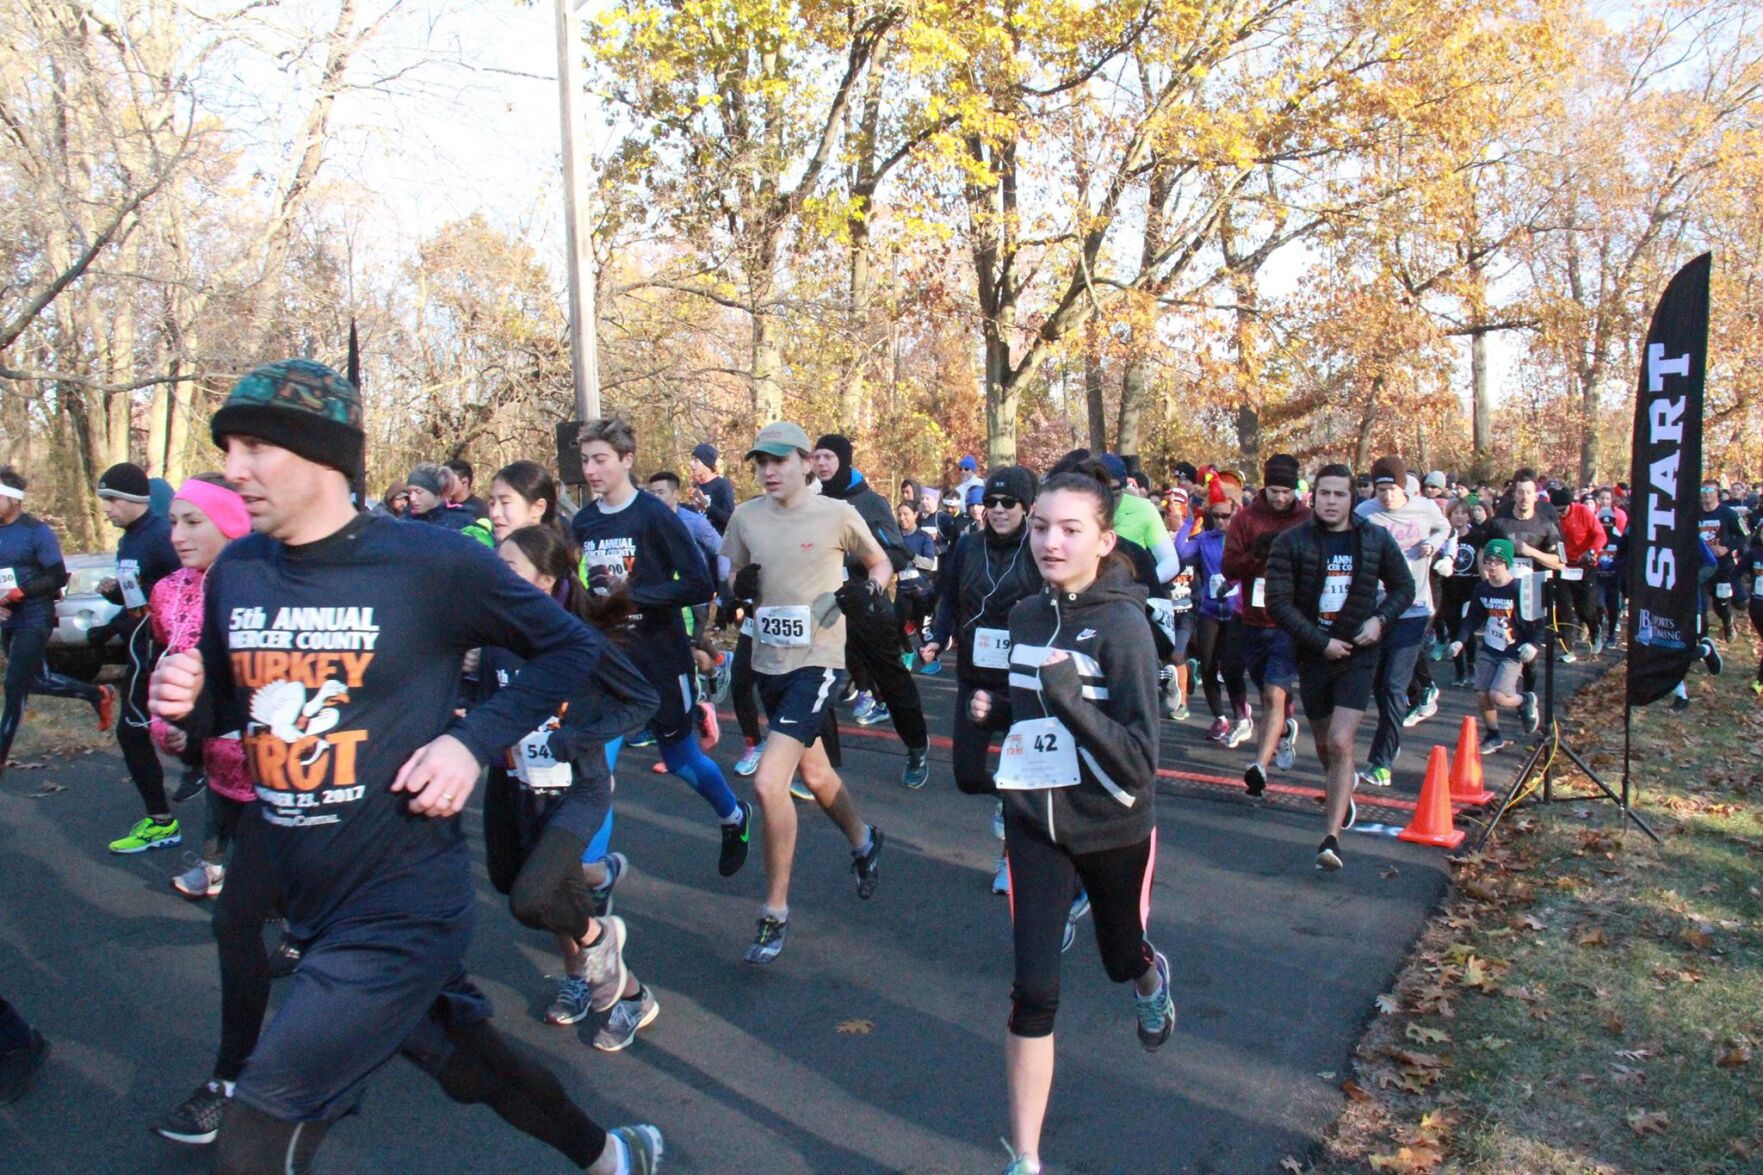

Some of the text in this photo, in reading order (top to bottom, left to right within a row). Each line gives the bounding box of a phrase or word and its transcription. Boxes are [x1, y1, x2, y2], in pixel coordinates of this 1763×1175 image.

[1646, 343, 1690, 590] START
[598, 538, 636, 549] ANNUAL
[229, 607, 380, 631] 5th ANNUAL
[762, 617, 804, 637] 2355
[296, 632, 380, 650] COUNTY
[230, 651, 376, 688] TURKEY
[1034, 733, 1059, 752] 42
[322, 785, 366, 804] 2017
